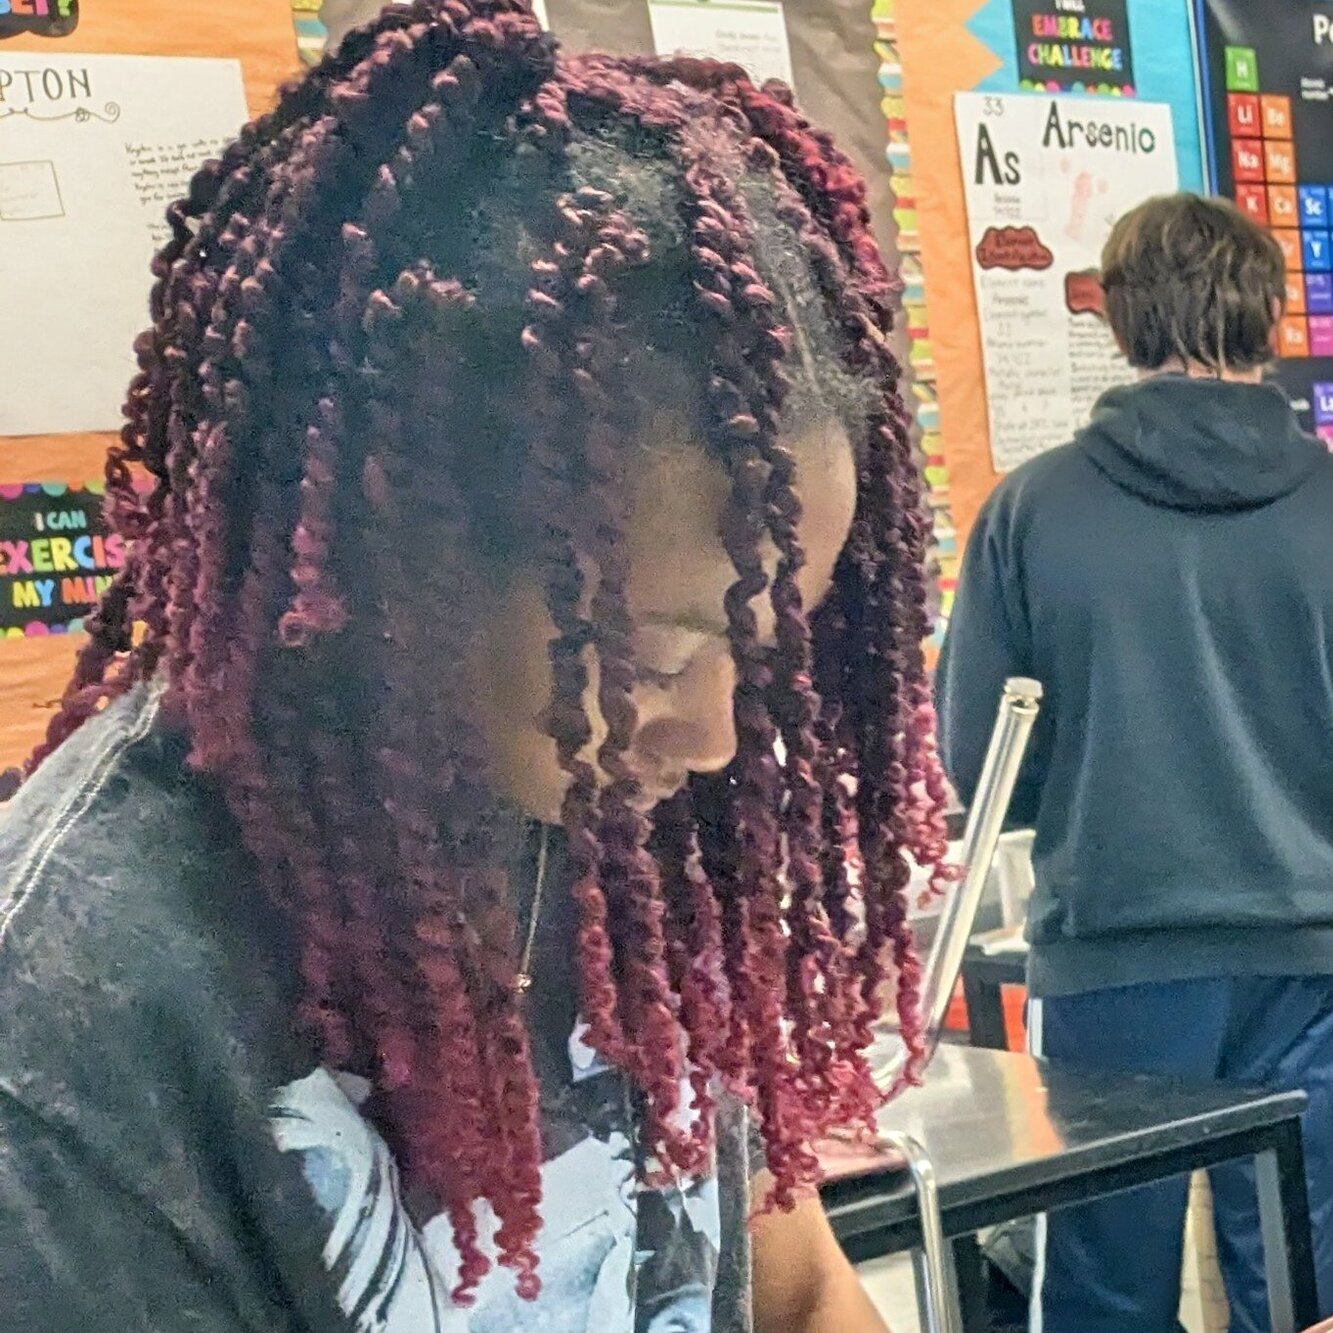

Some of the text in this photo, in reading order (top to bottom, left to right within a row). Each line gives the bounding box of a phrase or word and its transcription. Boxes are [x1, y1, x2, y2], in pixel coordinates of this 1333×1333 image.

[1031, 14, 1113, 42] EMBRACE
[1027, 42, 1123, 71] CHALLENGE
[983, 96, 1005, 117] 33
[974, 123, 1021, 186] As
[35, 510, 87, 531] I CAN
[0, 534, 126, 576] XERCIS
[12, 578, 55, 608] MY
